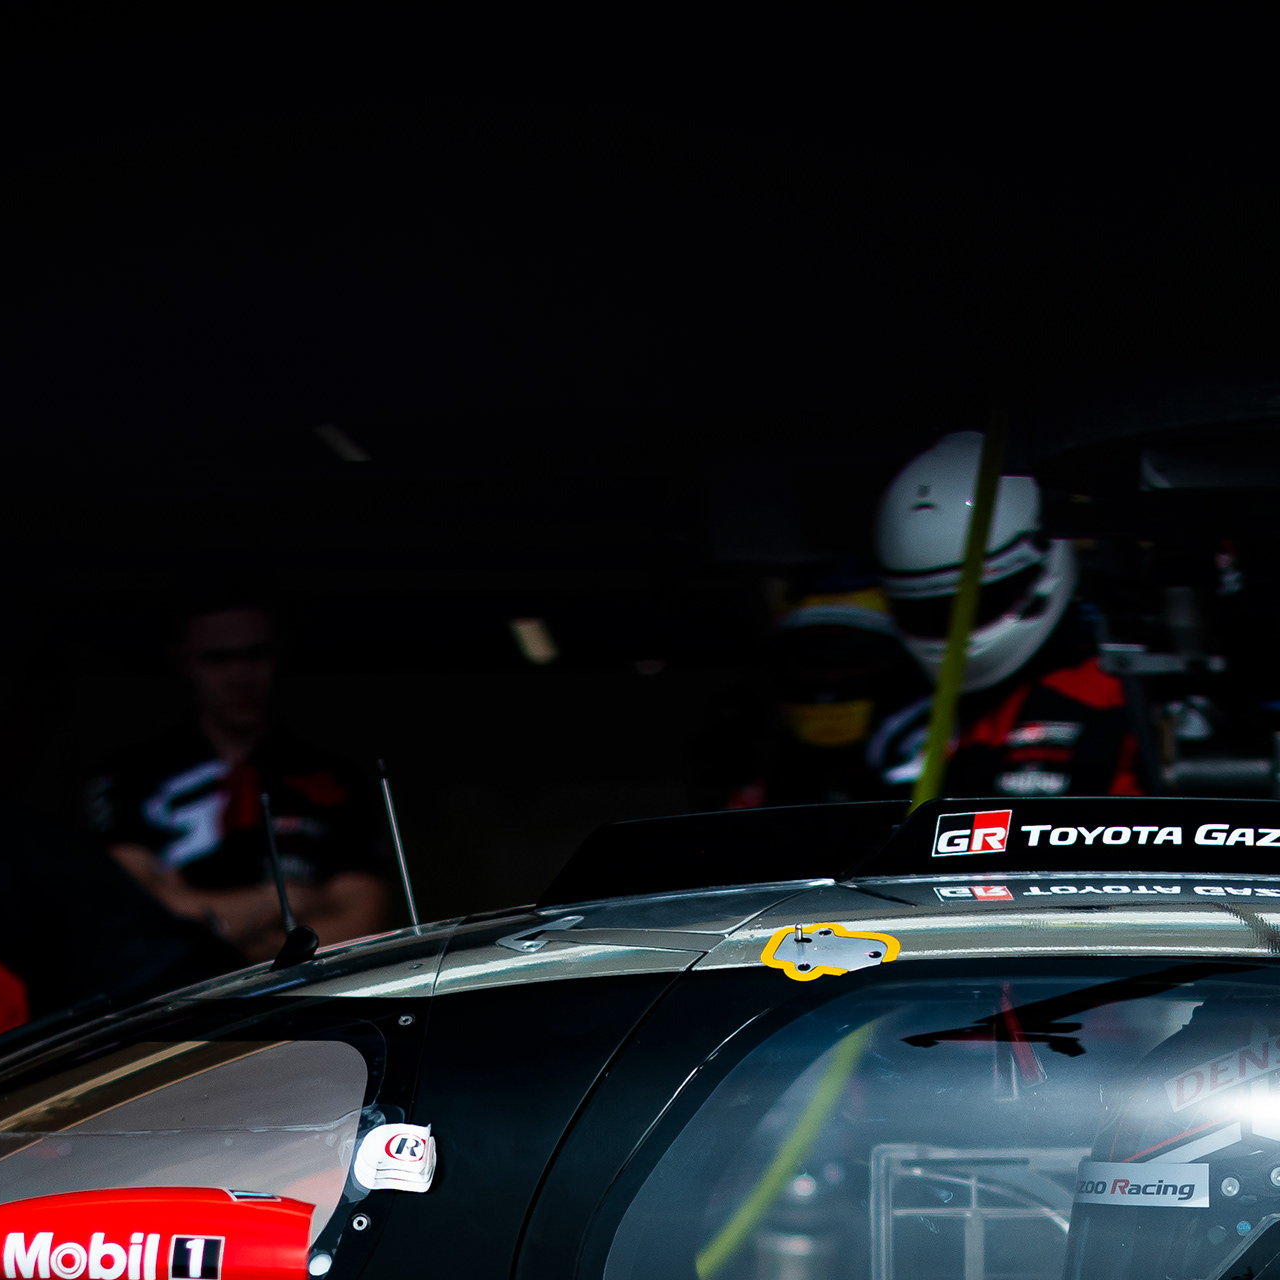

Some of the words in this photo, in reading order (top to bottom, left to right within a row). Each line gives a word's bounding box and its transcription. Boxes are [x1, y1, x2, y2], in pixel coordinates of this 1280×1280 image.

[936, 827, 1006, 852] GR
[1021, 824, 1183, 847] TOYOTA
[1110, 1179, 1196, 1201] Racing
[3, 1232, 160, 1280] Mobil
